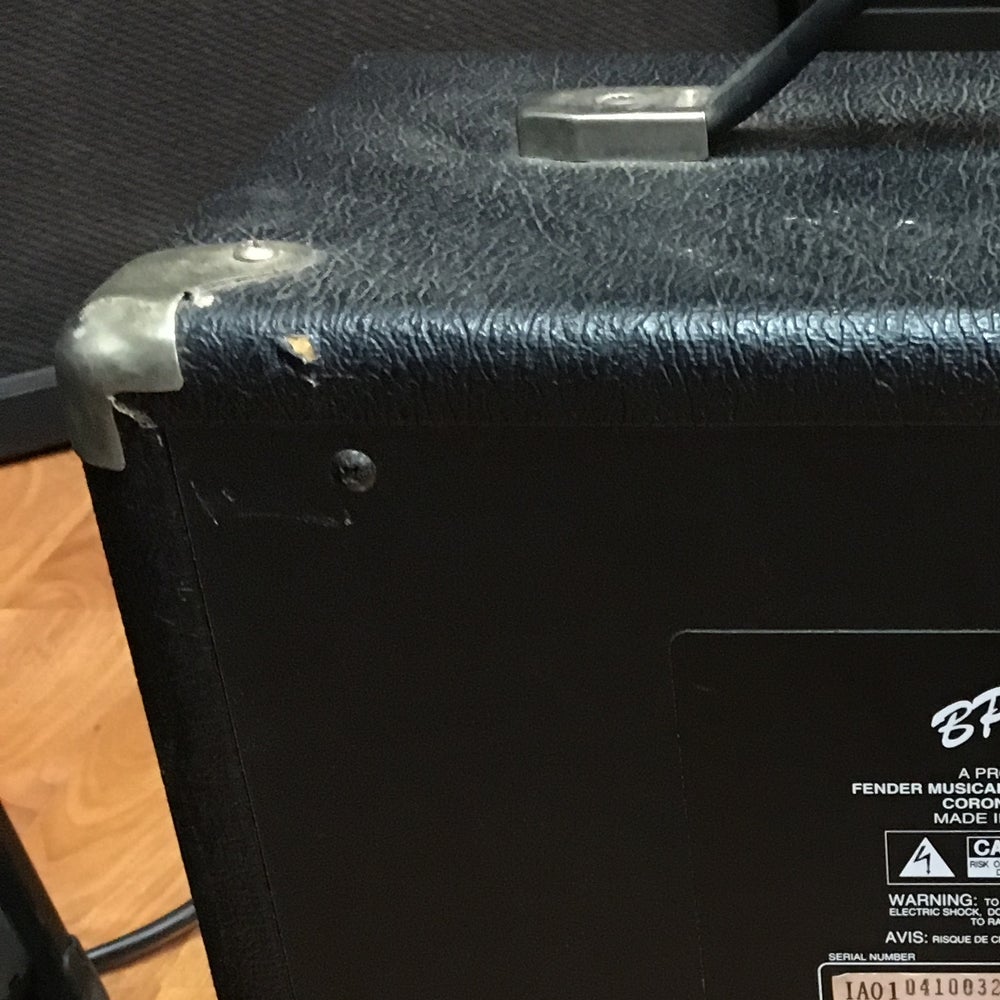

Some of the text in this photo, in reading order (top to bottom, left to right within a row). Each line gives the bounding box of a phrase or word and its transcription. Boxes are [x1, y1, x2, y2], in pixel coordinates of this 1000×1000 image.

[958, 767, 971, 780] A
[851, 782, 923, 795] FENDER
[933, 812, 988, 825] MADE
[969, 860, 989, 869] RISK
[888, 893, 978, 907] WARNING:
[983, 897, 1000, 907] TO
[888, 907, 941, 917] ELECTRIC
[970, 917, 986, 927] TO
[884, 930, 929, 944] AVIS:
[931, 934, 972, 944] RISQUE
[973, 935, 989, 944] DE
[828, 952, 916, 962] SERIAL NUMBER
